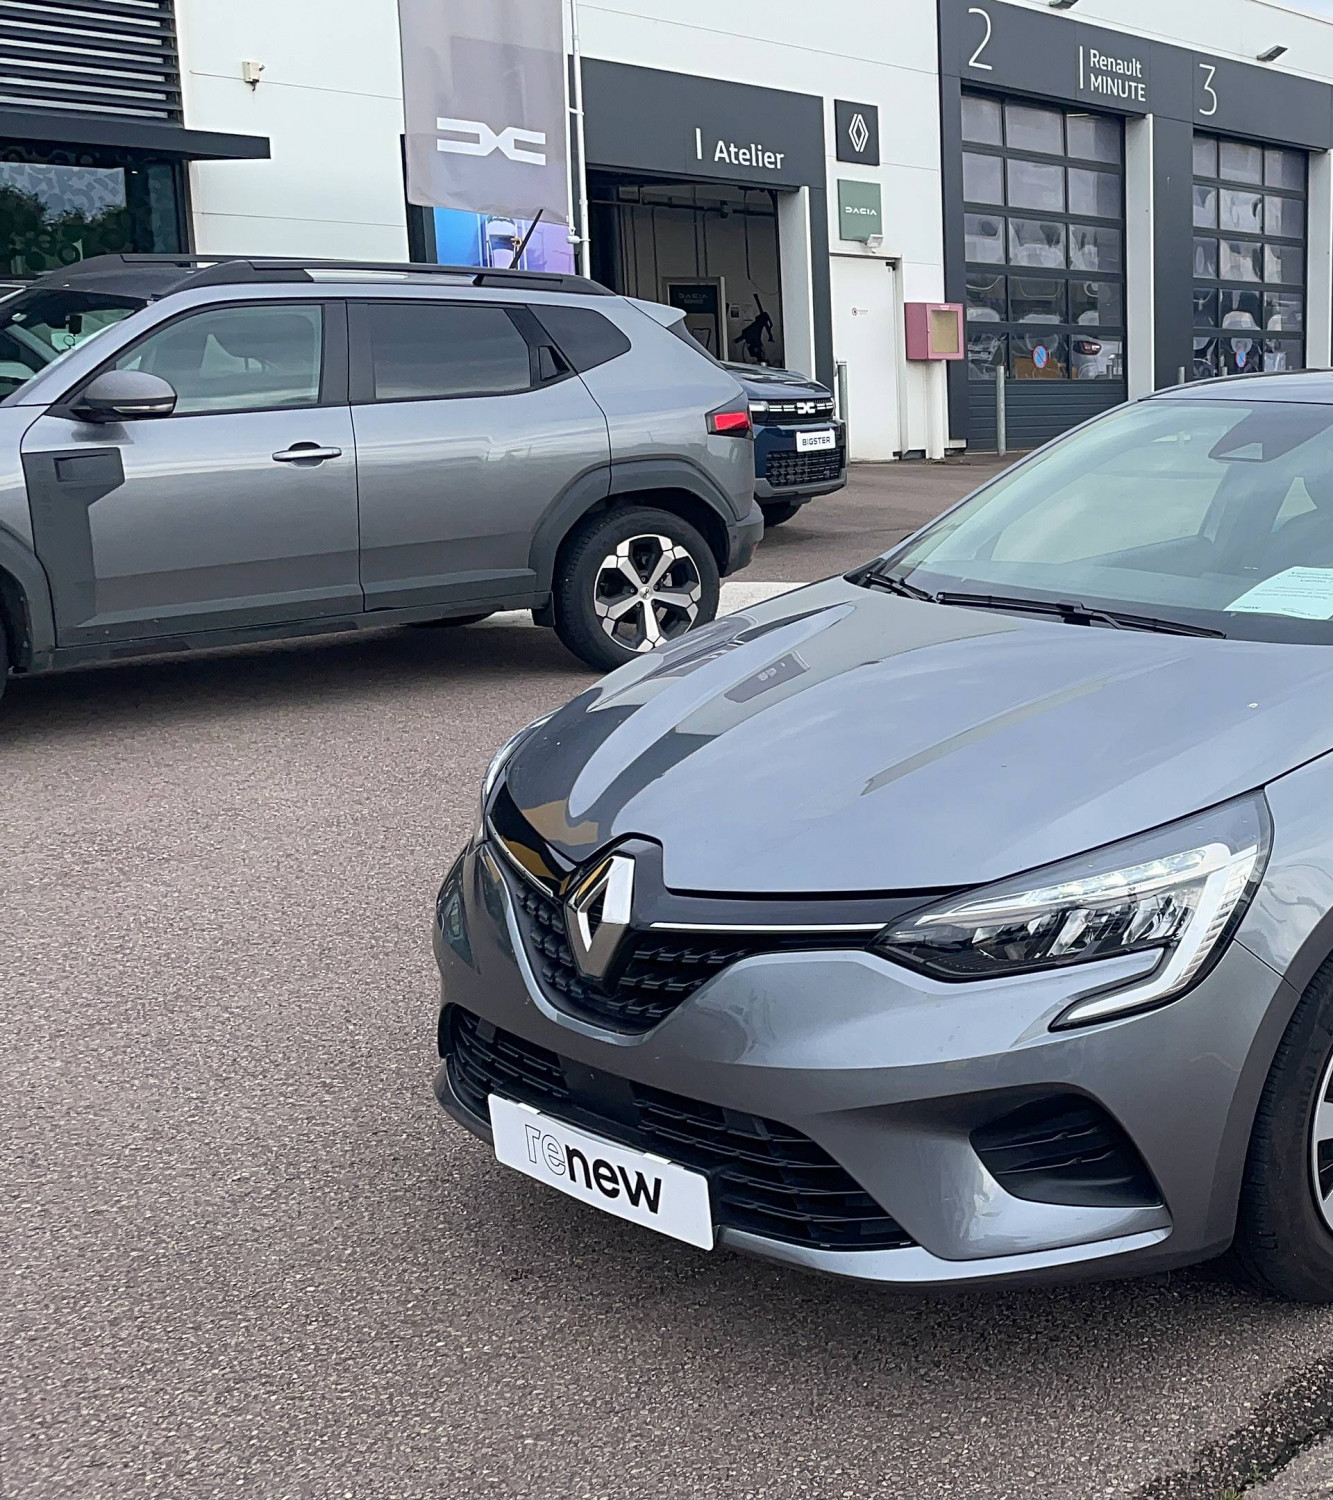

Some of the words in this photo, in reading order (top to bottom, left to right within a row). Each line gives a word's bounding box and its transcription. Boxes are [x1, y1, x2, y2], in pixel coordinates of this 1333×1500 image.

[968, 7, 993, 71] 2
[1089, 48, 1142, 78] Renault
[1089, 73, 1146, 102] MINUTE
[1198, 63, 1218, 116] 3
[713, 139, 785, 170] Atelier
[845, 206, 878, 216] DACIA
[802, 436, 831, 446] BIGSTER
[524, 1123, 662, 1215] renew
